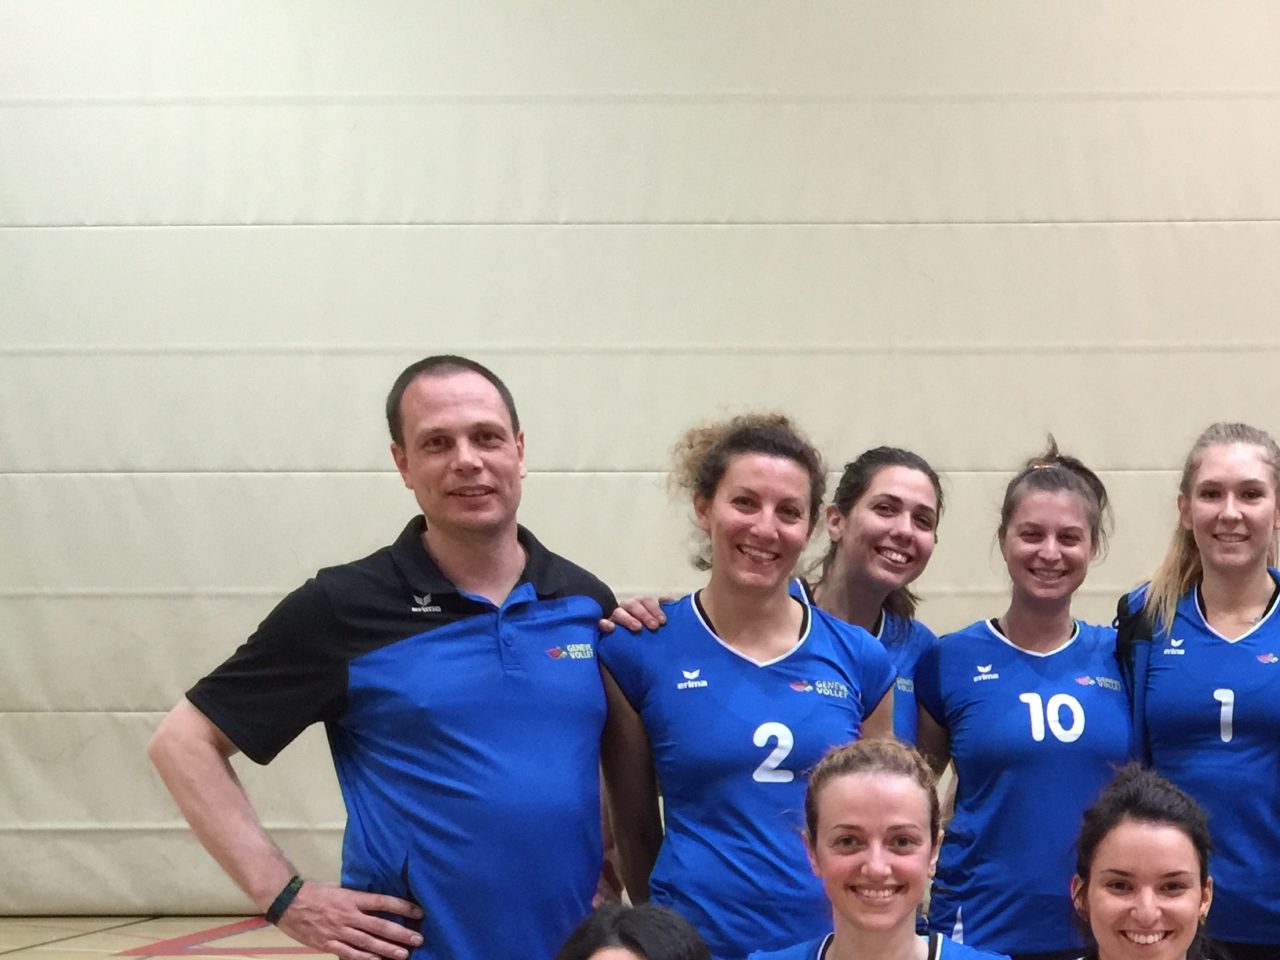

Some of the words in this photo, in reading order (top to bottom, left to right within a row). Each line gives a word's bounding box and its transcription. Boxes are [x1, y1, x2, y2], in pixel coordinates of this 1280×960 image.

[677, 680, 708, 690] erima
[816, 687, 848, 699] VOLLEY
[973, 673, 999, 682] erima
[1019, 692, 1086, 742] 10
[1213, 688, 1235, 742] 1
[753, 721, 794, 783] 2
